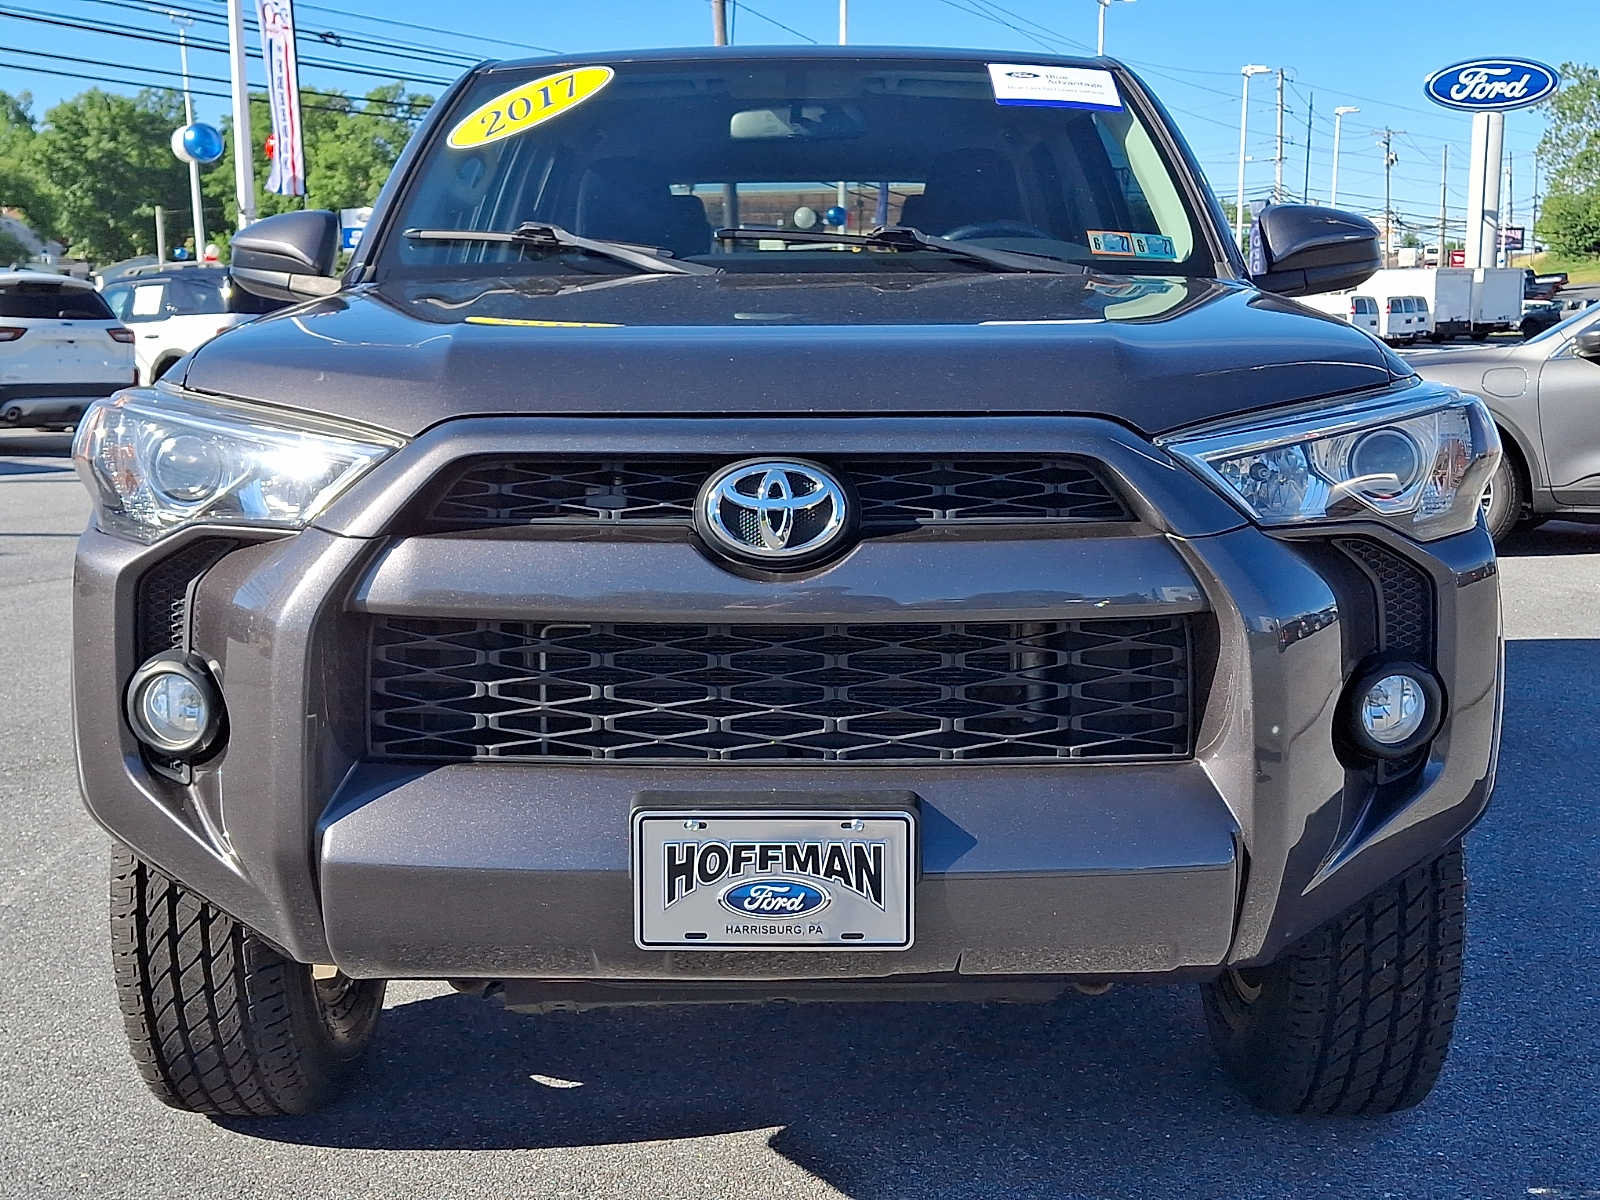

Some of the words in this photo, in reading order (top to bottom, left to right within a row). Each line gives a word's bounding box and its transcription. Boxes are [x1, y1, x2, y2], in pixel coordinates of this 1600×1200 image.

[1450, 67, 1531, 101] Ford
[480, 74, 576, 137] 2017
[1093, 236, 1101, 251] 6
[1137, 239, 1146, 253] 6
[663, 840, 887, 912] HOFFMAN
[743, 885, 806, 912] Ford
[725, 924, 805, 936] HARRISBURG,
[808, 924, 823, 935] PA
